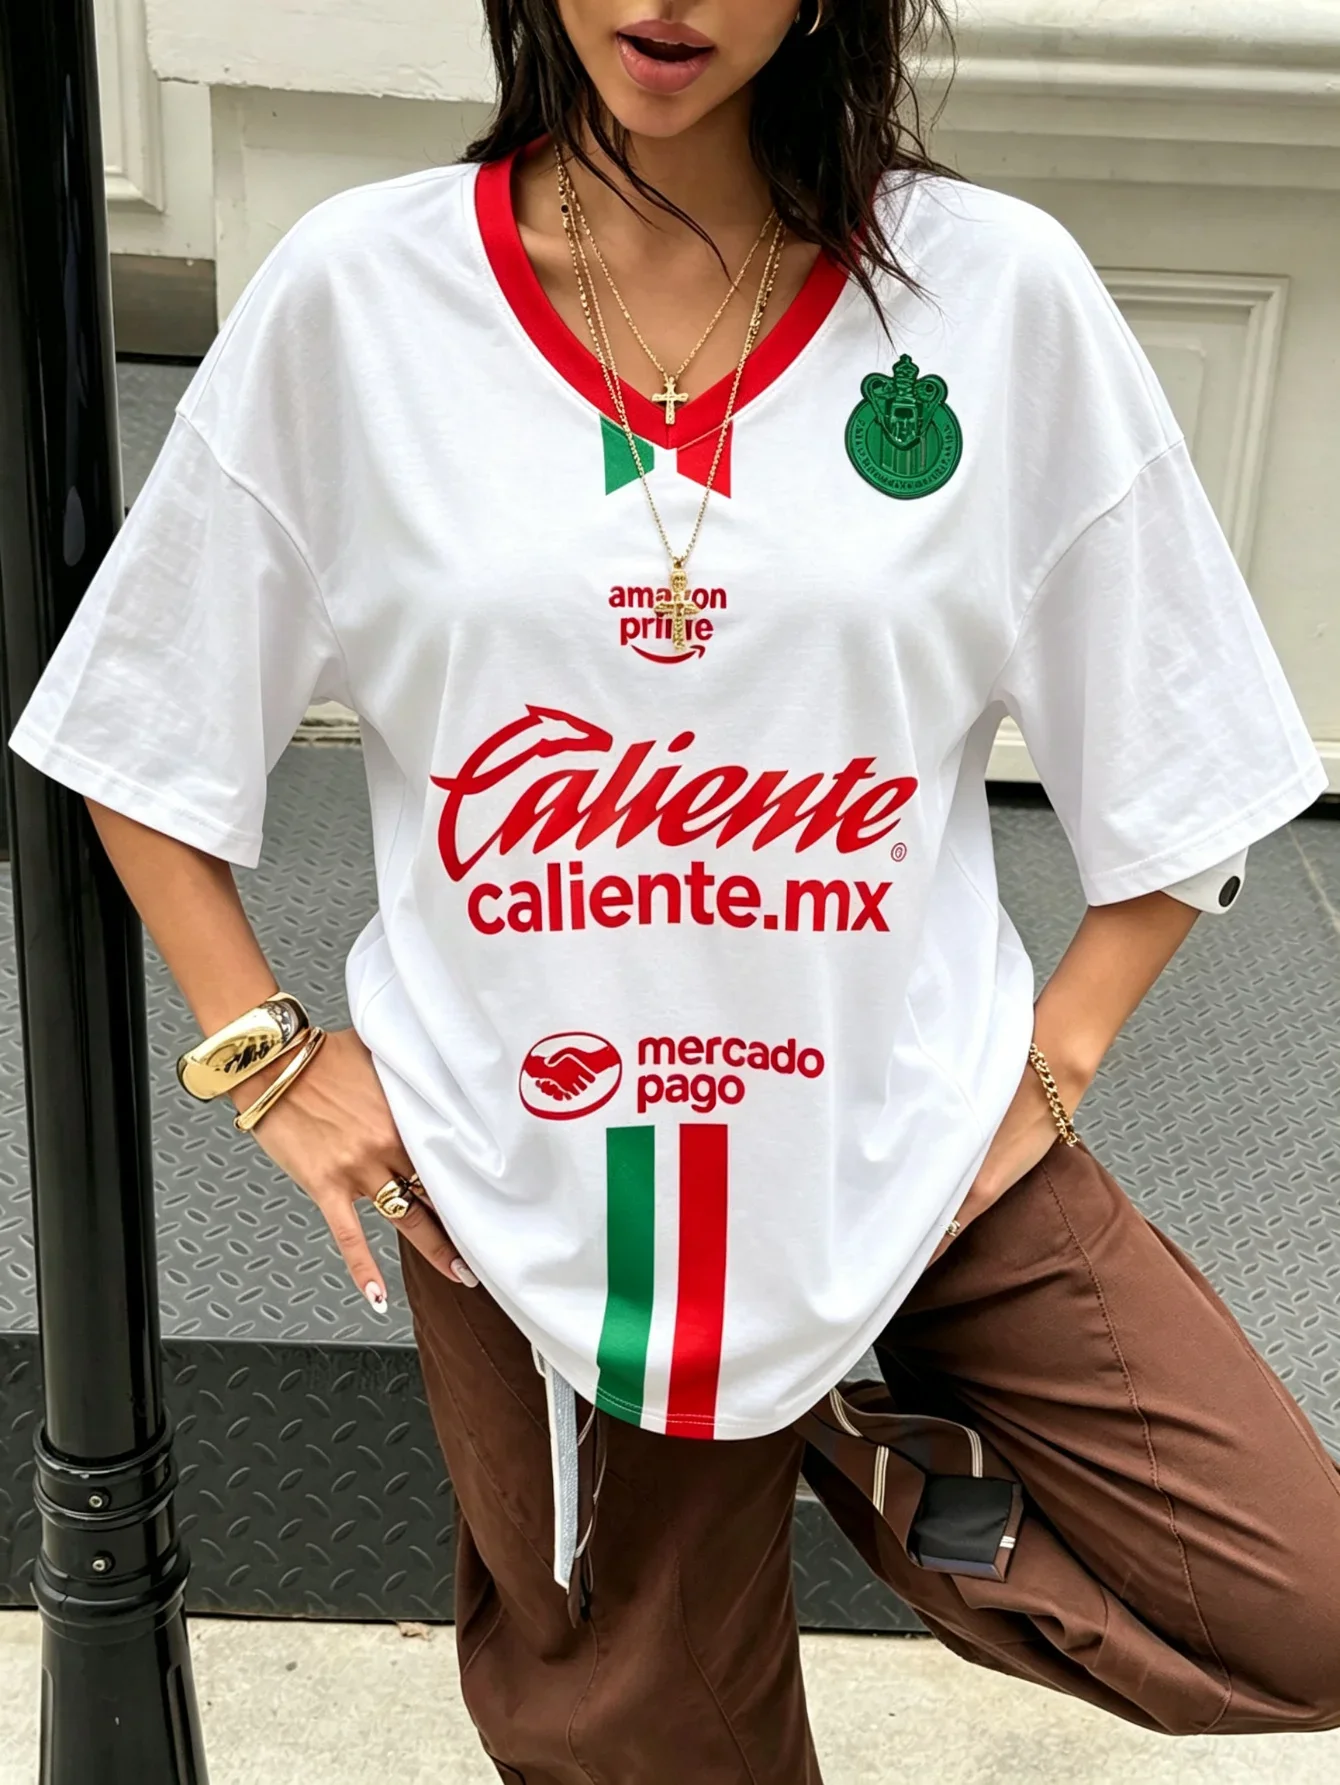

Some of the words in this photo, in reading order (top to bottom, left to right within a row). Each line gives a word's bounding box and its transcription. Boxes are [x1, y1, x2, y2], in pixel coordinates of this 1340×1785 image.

[608, 585, 727, 610] amaon
[430, 704, 919, 882] Caliente
[467, 860, 893, 936] caliente.mx
[637, 1035, 826, 1080] mercado
[636, 1072, 747, 1115] pago
